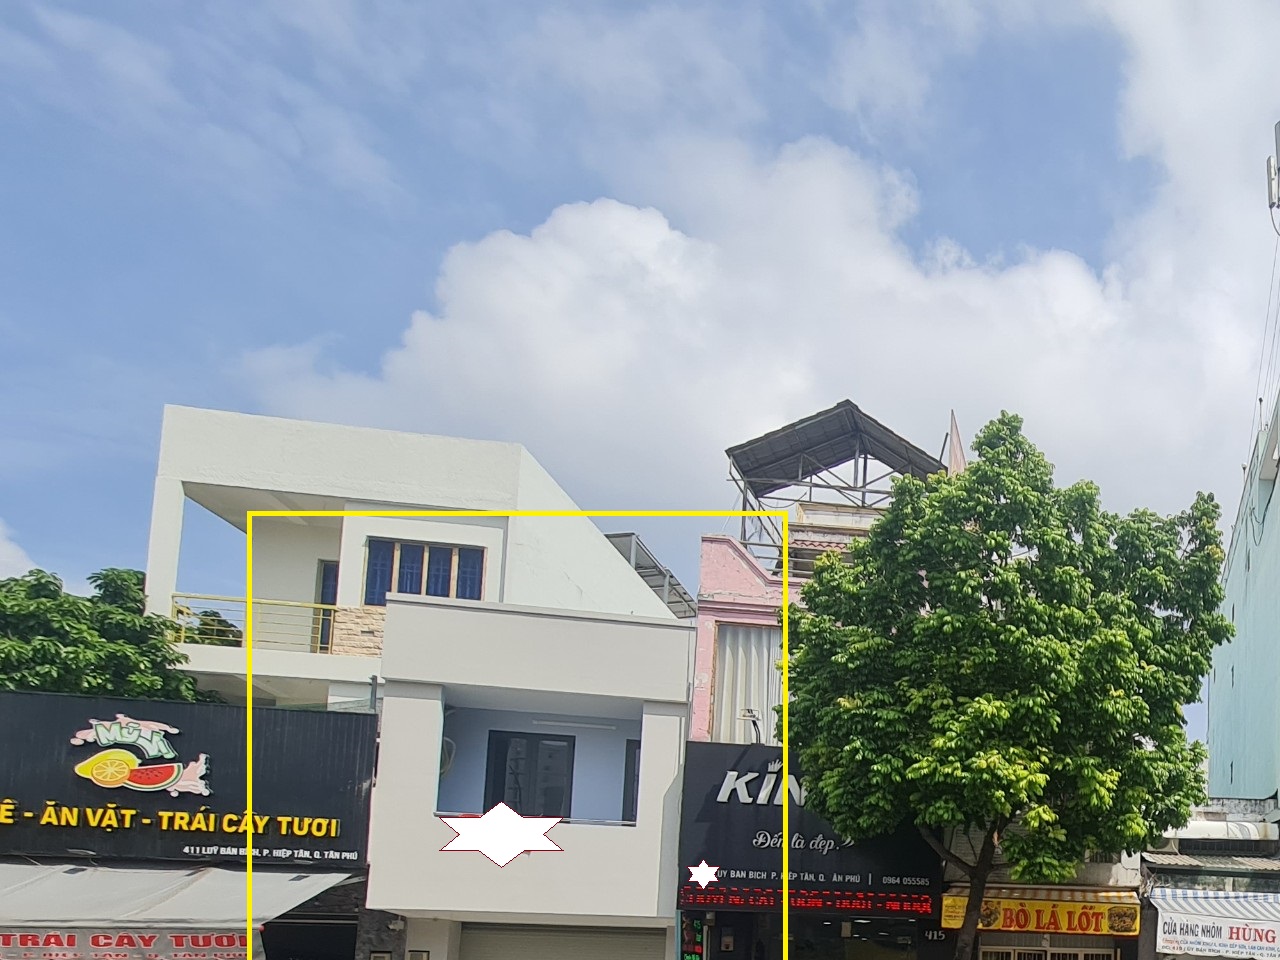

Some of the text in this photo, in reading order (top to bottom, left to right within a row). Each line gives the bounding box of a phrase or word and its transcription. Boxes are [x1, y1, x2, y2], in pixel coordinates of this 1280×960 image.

[717, 770, 808, 806] KIN
[40, 800, 79, 826] ĂN
[86, 803, 137, 832] VẶT
[158, 805, 215, 831] TRÁI
[223, 809, 270, 834] CÂY
[277, 816, 340, 837] TƯƠI
[183, 846, 200, 854] 411
[791, 833, 806, 849] là
[1002, 902, 1031, 929] BÒ
[1035, 903, 1062, 931] LÁ
[0, 931, 248, 949] TRÁI CÂY TƯƠI
[925, 930, 945, 941] 415
[1162, 917, 1178, 935] CỬA
[1180, 919, 1200, 937] HÀNG
[1228, 923, 1276, 944] HÙNG
